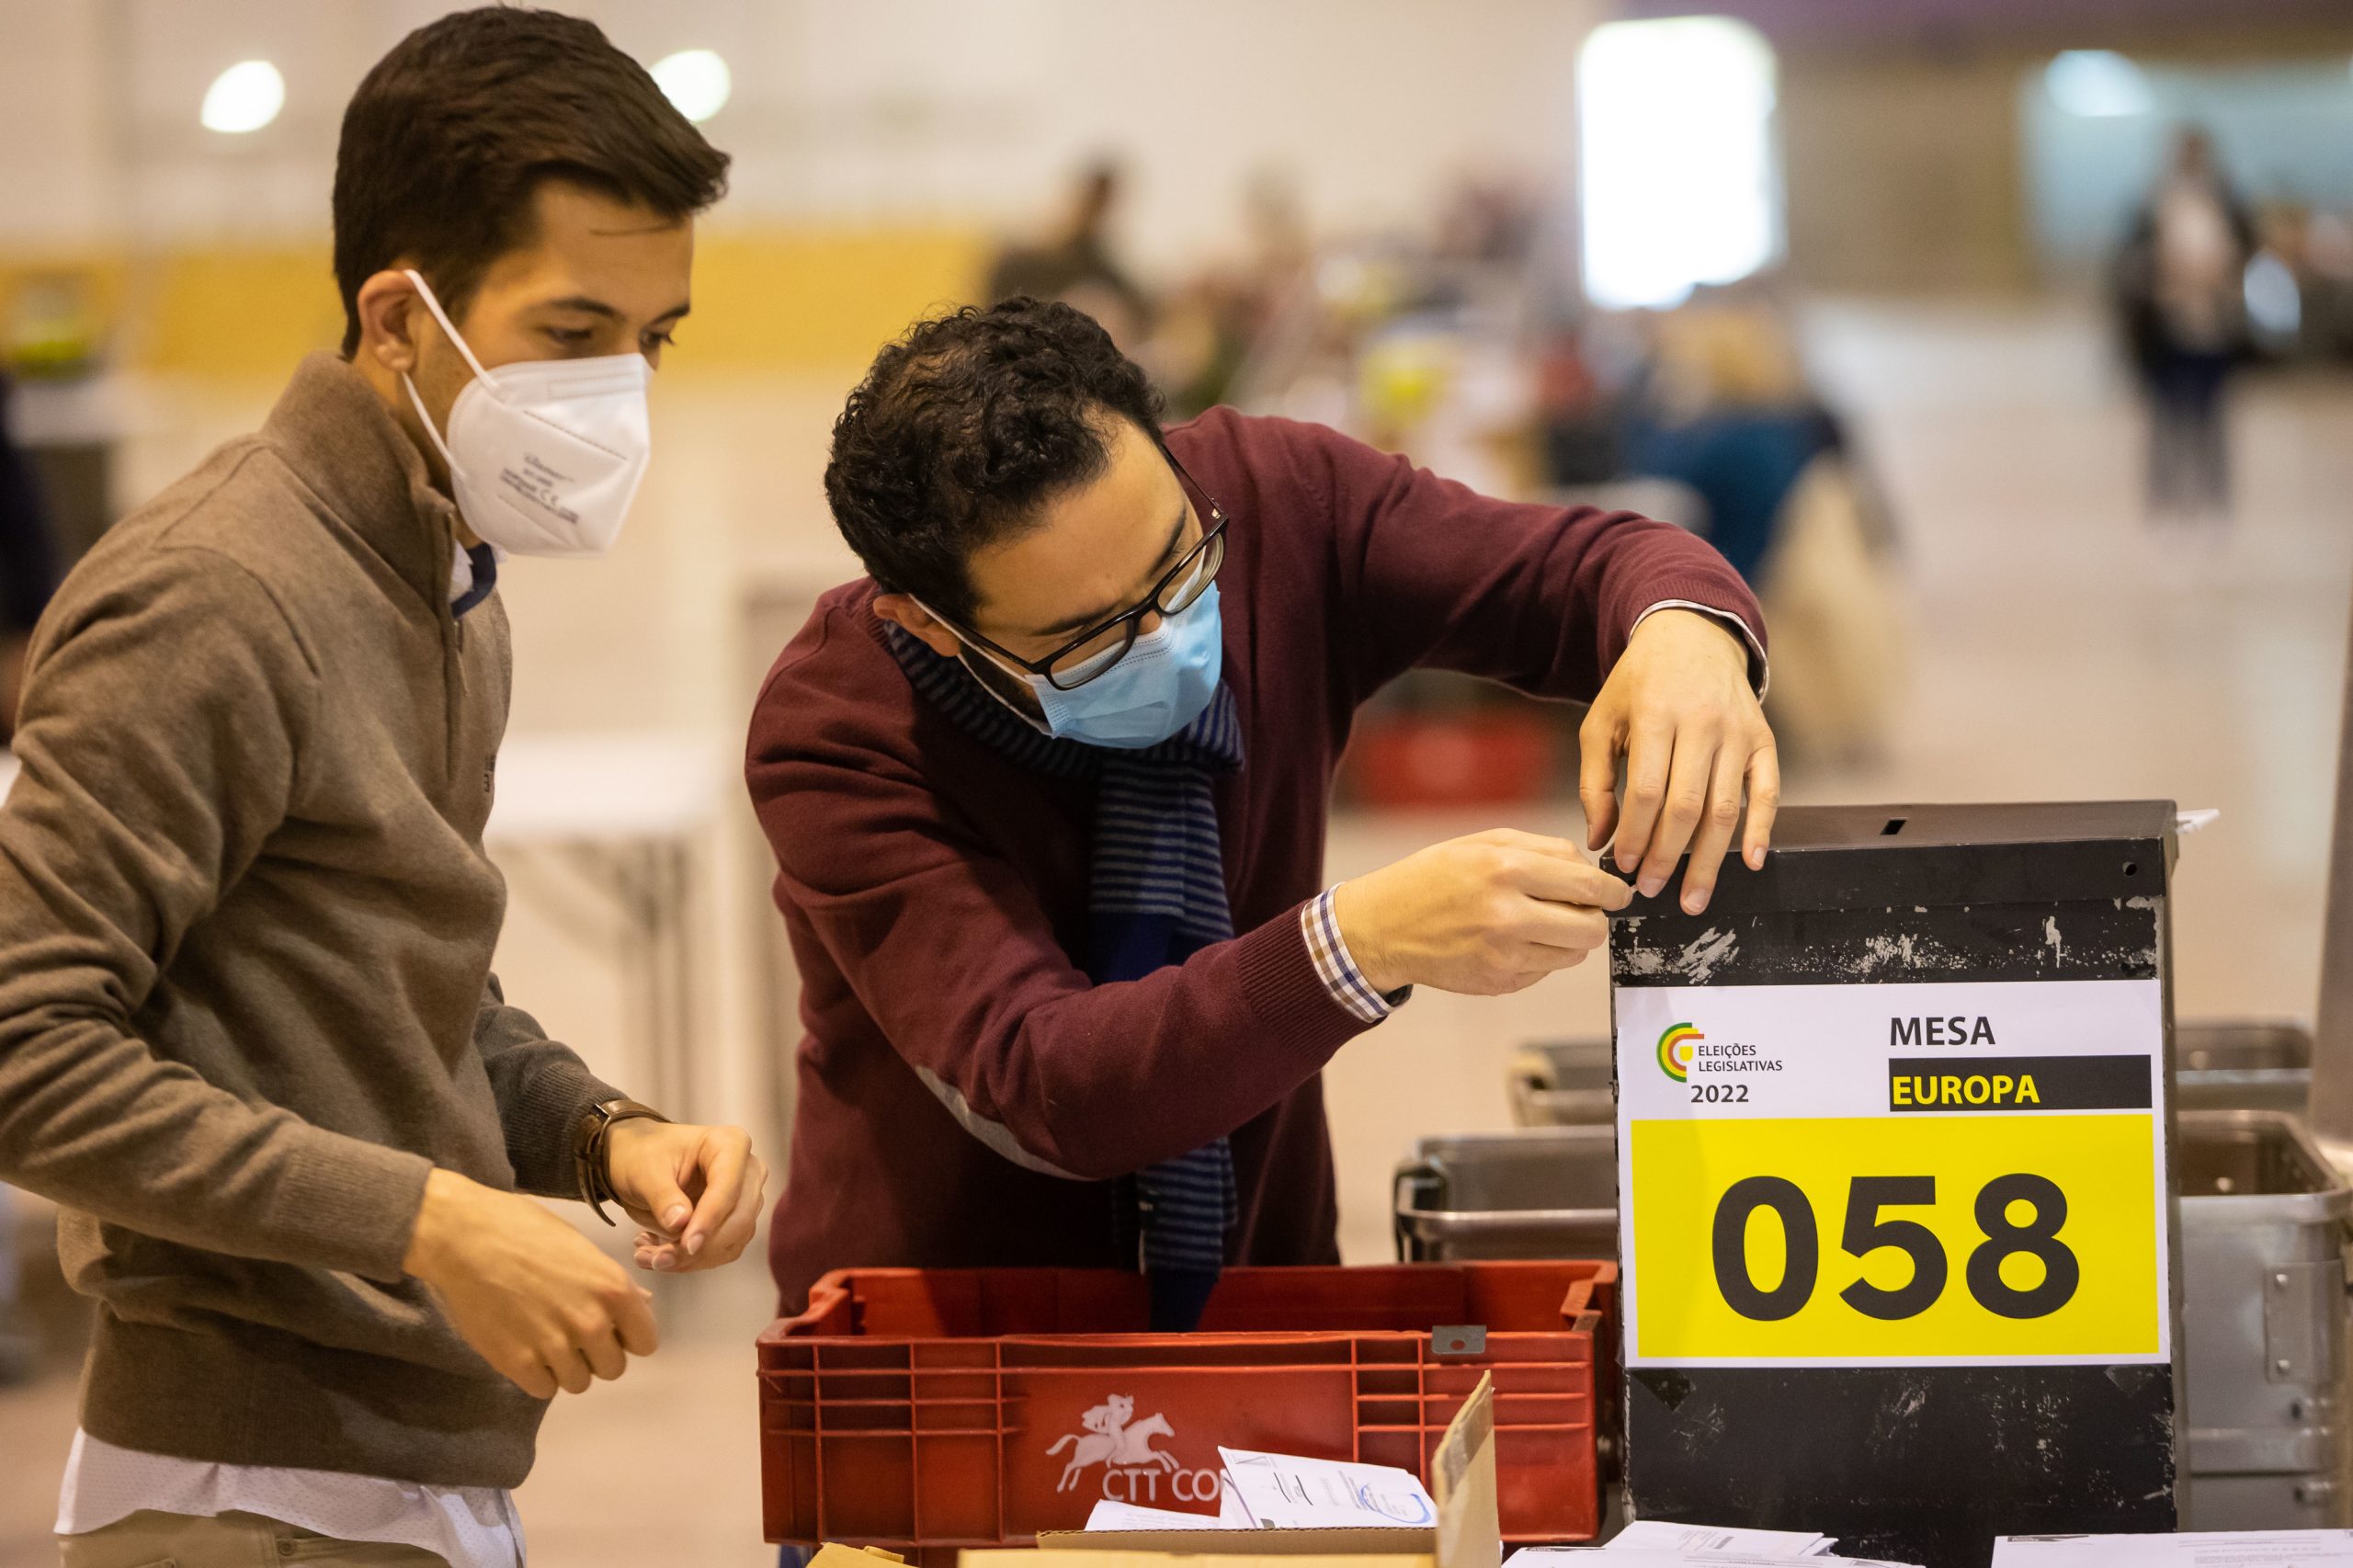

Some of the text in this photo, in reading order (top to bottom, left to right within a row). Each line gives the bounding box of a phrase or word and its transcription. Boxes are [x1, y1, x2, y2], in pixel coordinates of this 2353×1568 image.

[1890, 1016, 1996, 1046] MESA
[1698, 1042, 1756, 1059] ELEIÇÕES
[1698, 1060, 1783, 1073] LEGISLATIVAS
[1690, 1084, 1749, 1103] 2022
[1893, 1074, 2040, 1105] EUROPA
[1711, 1173, 2080, 1322] 058
[1102, 1468, 1225, 1502] CTT CO
